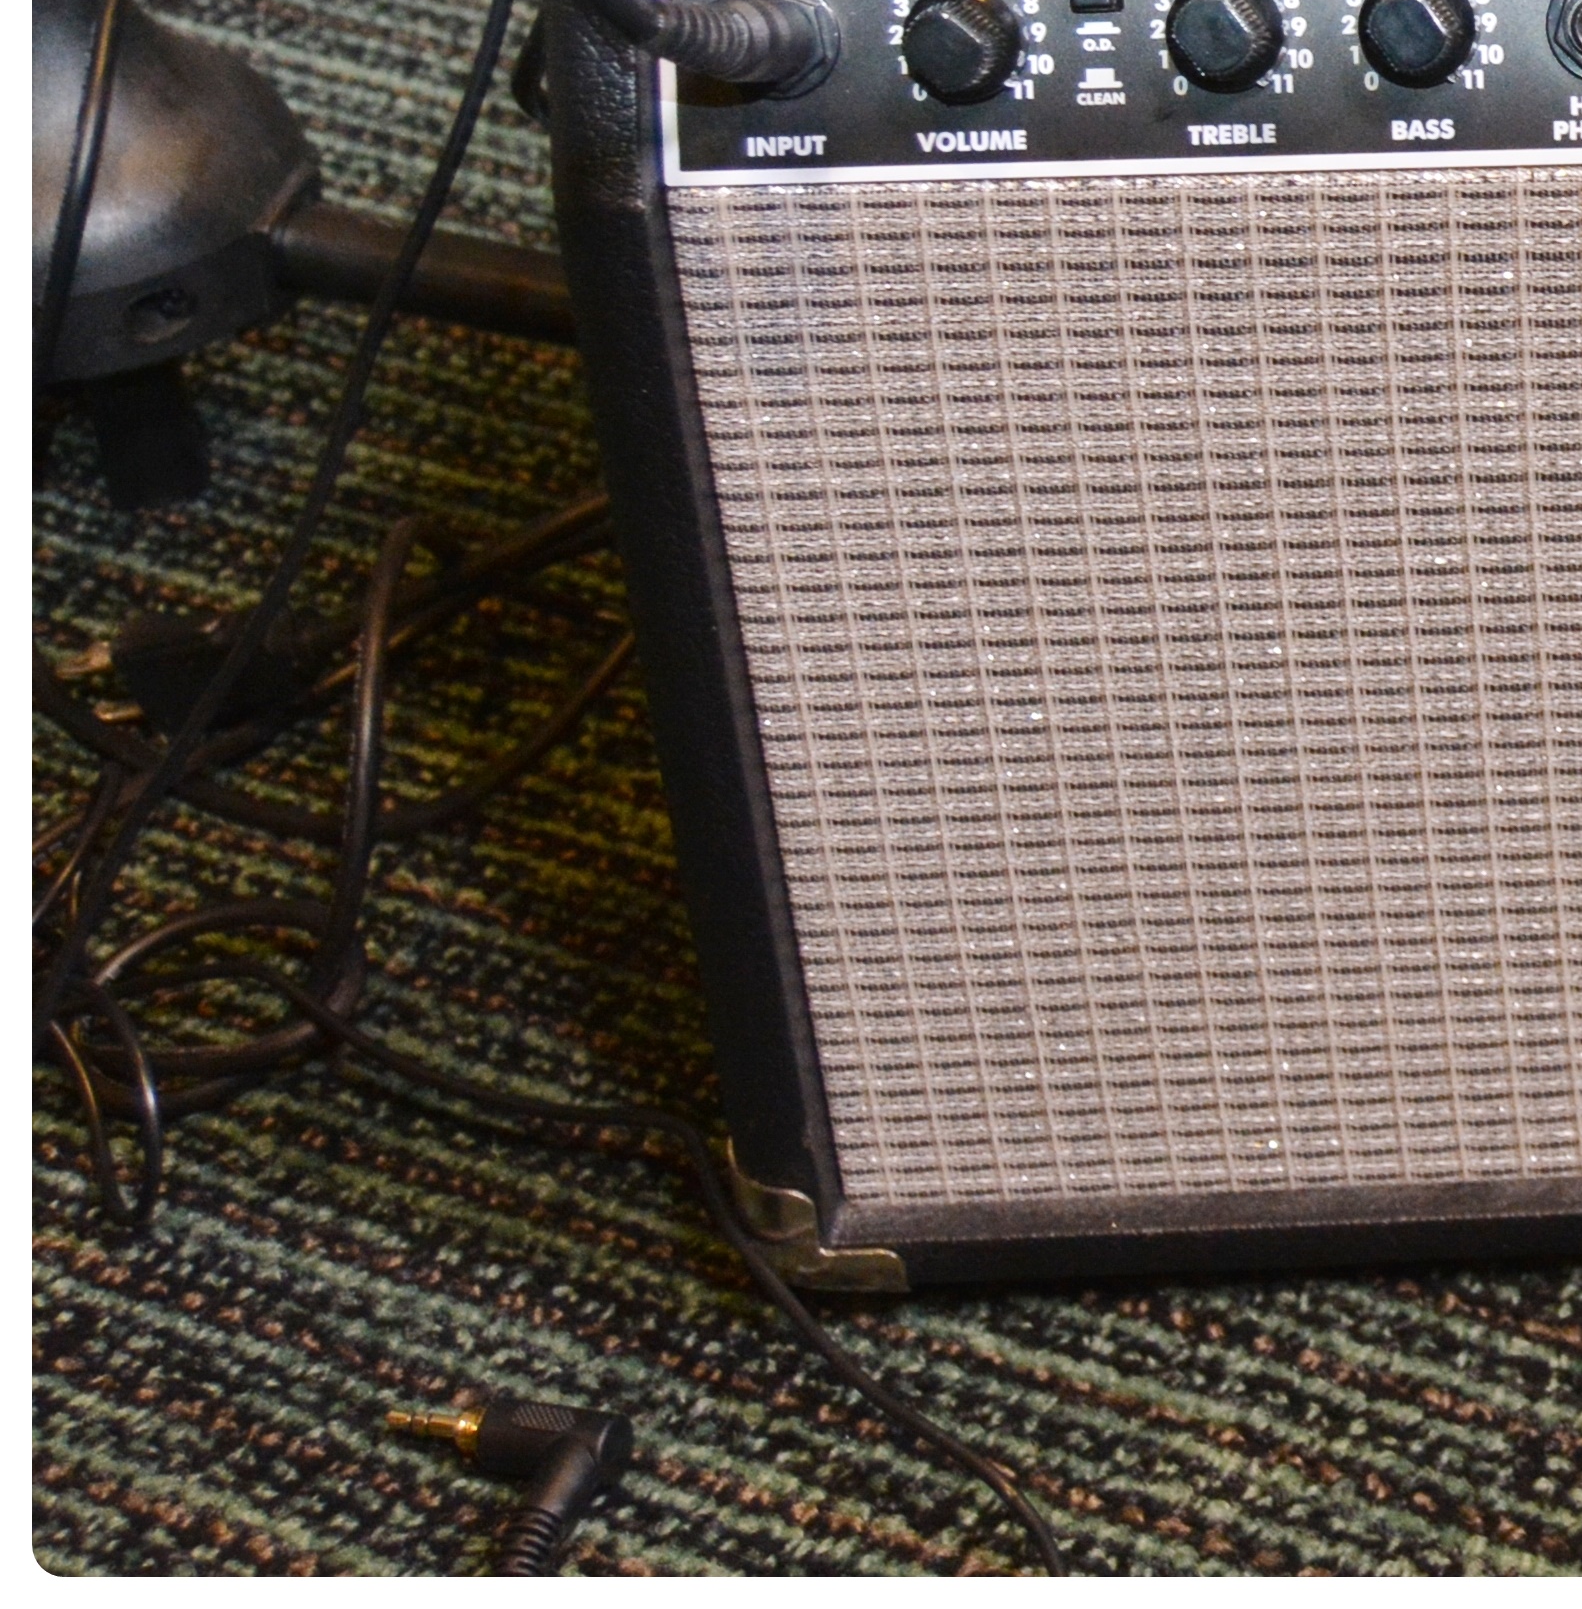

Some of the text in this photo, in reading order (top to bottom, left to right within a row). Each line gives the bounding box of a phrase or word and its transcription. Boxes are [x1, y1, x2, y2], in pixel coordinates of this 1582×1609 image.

[1150, 20, 1165, 39] 2
[1291, 17, 1307, 37] 9
[1341, 15, 1356, 34] 2
[1481, 12, 1497, 32] 9
[888, 25, 904, 45] 2
[1030, 23, 1047, 42] 9
[1082, 39, 1116, 51] O.D.
[1478, 45, 1504, 64] 10
[1027, 55, 1055, 74] 10
[1158, 50, 1169, 69] 1
[1288, 49, 1313, 69] 10
[1350, 46, 1359, 64] 1
[1173, 76, 1188, 95] 0
[1271, 74, 1294, 93] 11
[1364, 71, 1379, 91] 0
[1461, 70, 1484, 89] 11
[1012, 80, 1035, 99] 11
[1076, 92, 1126, 105] CLEAN
[1187, 123, 1276, 146] TREBLE
[1391, 118, 1455, 141] BASS
[746, 135, 827, 158] INPUT
[916, 128, 1028, 153] VOLUME
